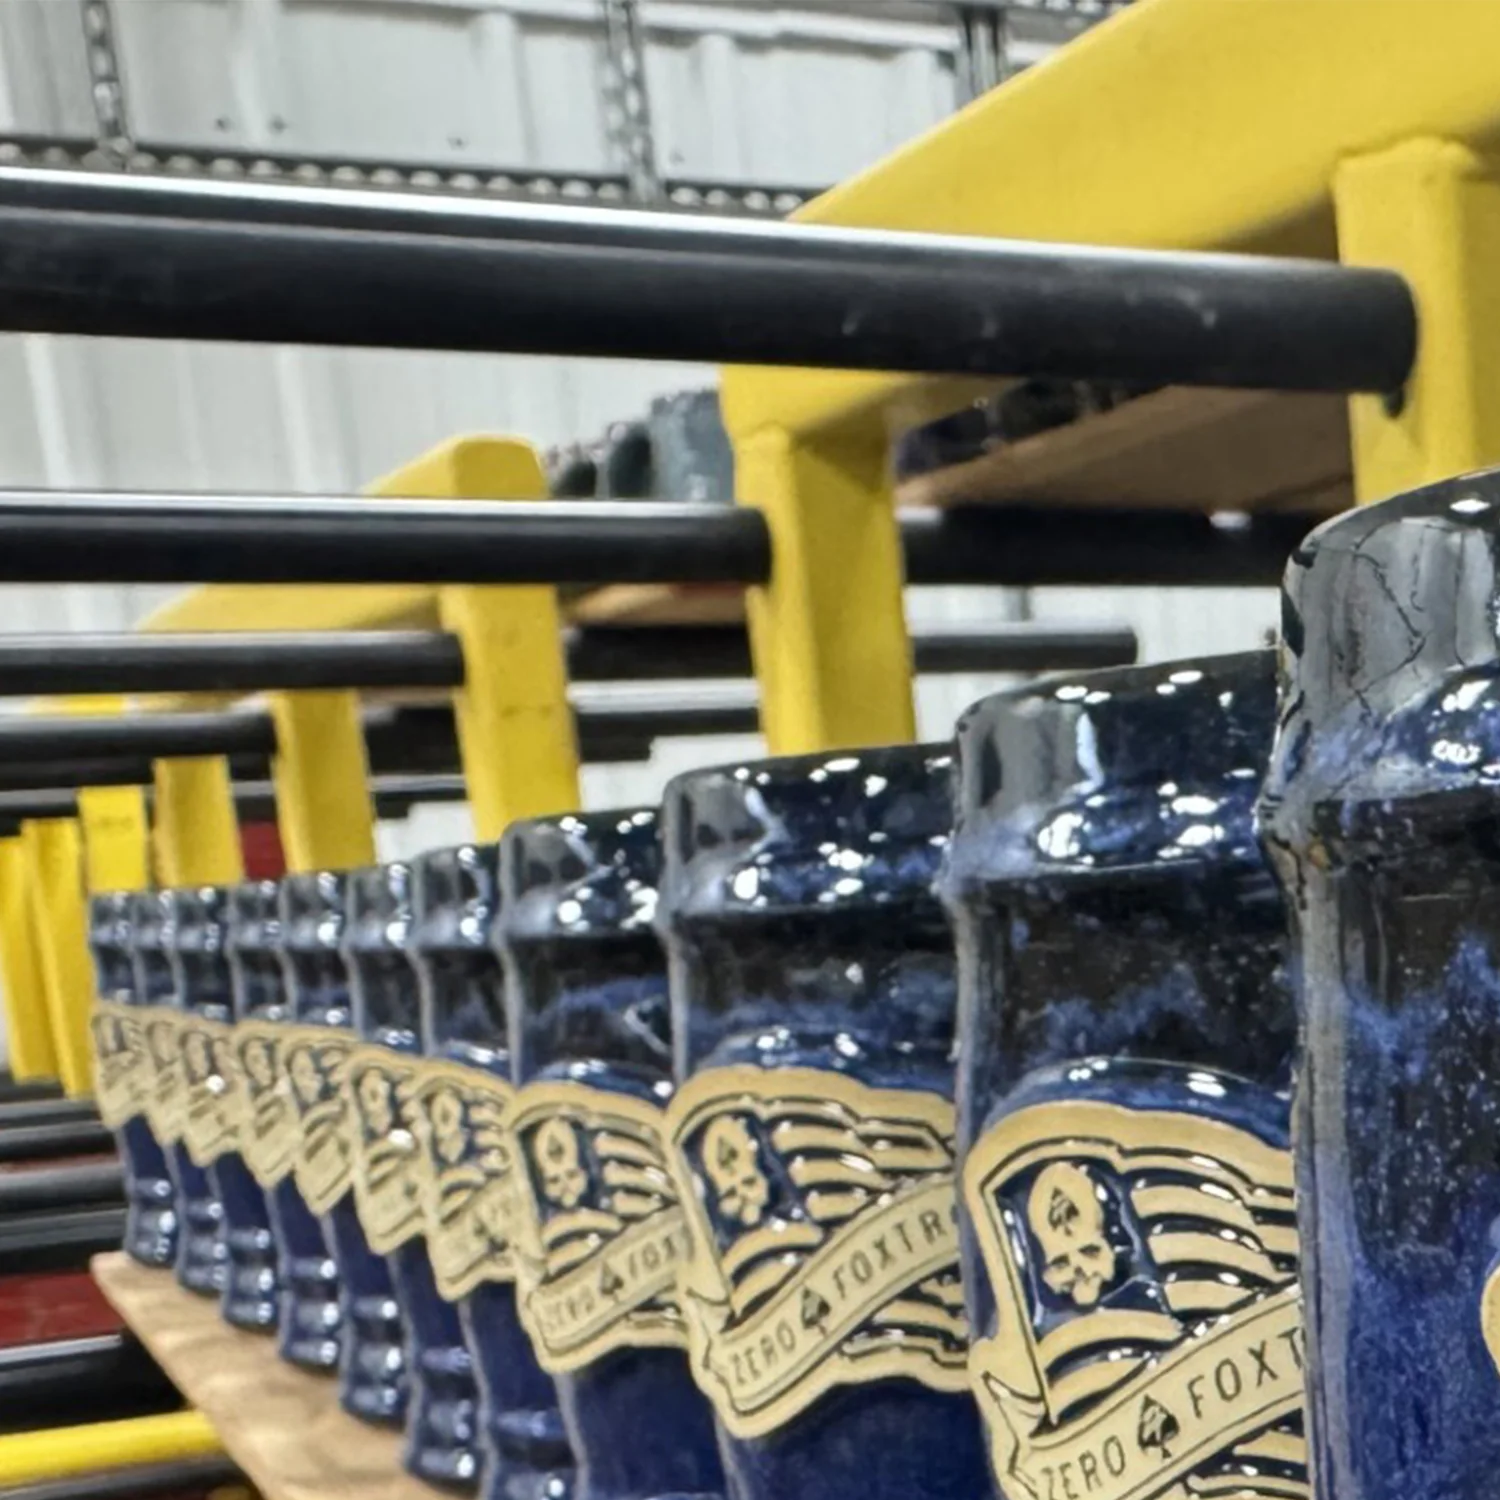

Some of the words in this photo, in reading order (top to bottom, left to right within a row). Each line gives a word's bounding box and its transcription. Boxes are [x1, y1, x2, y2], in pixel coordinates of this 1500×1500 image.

[729, 1319, 796, 1386] ZERO
[833, 1205, 959, 1299] FOXTR
[1187, 1326, 1304, 1419] FOXT
